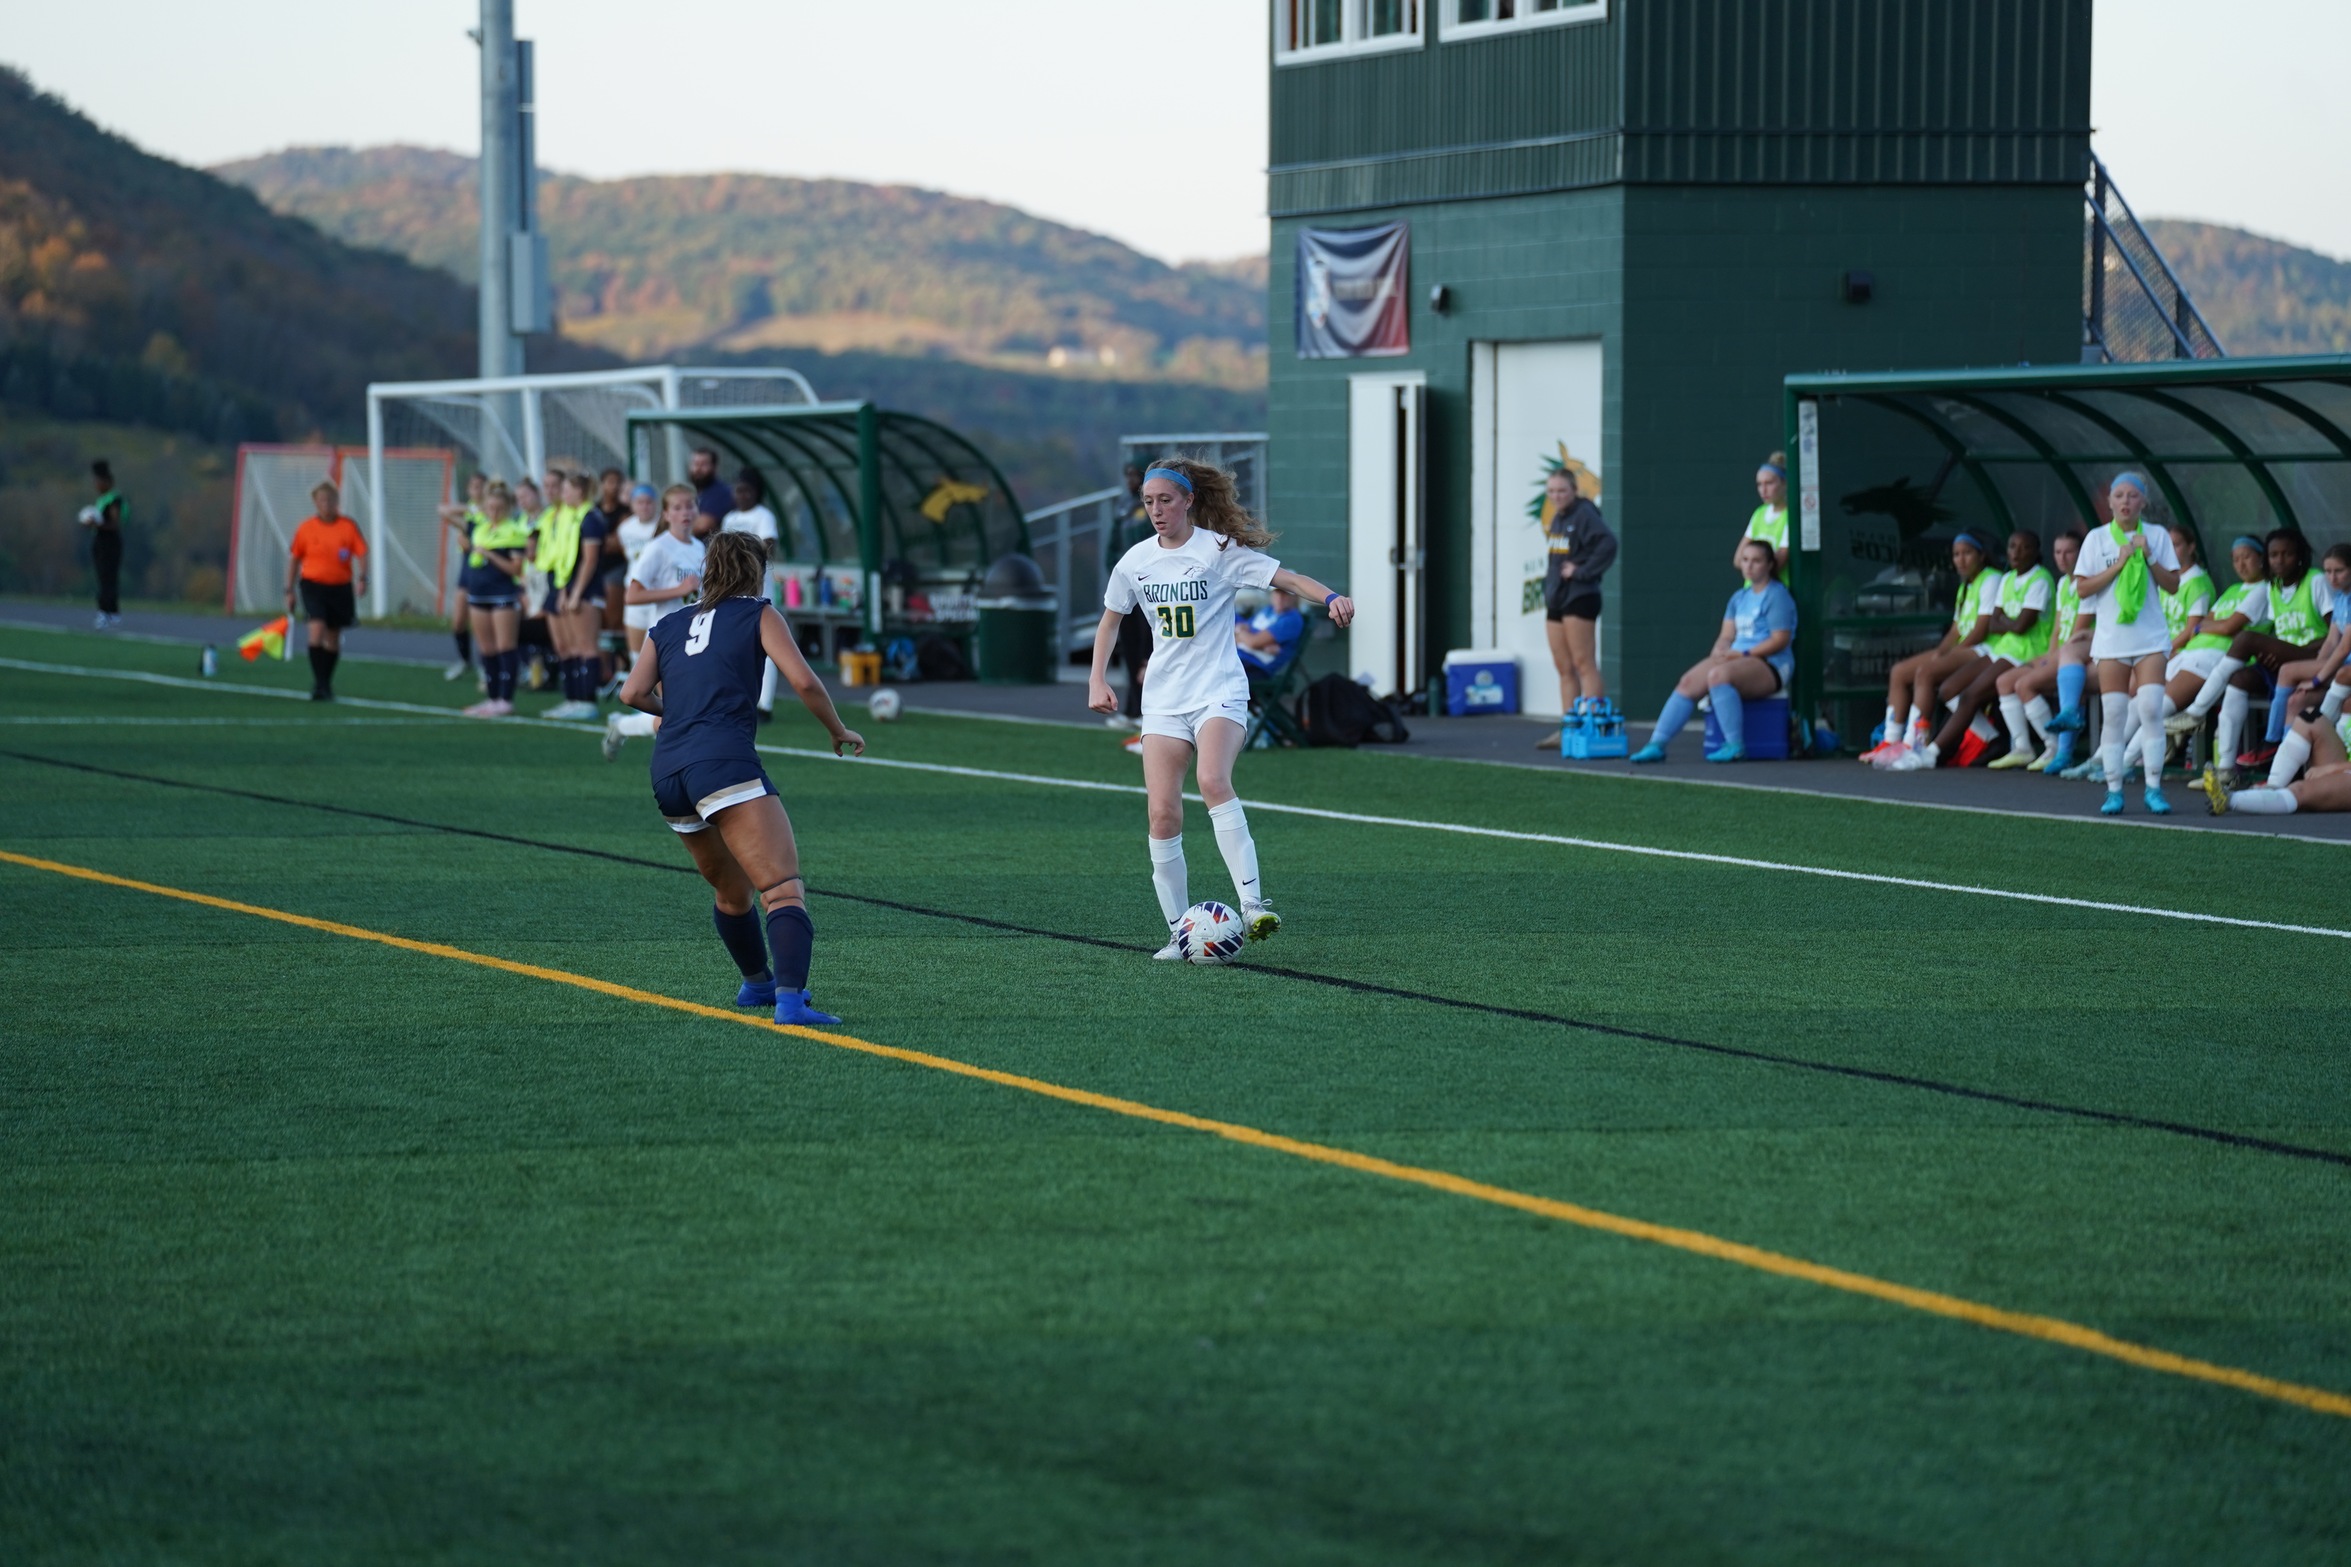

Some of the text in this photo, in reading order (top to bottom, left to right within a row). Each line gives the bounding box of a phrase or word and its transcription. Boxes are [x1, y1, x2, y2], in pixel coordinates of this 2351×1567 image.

[1143, 580, 1208, 603] BRONCOS
[684, 608, 717, 657] 9
[1157, 605, 1195, 639] 30
